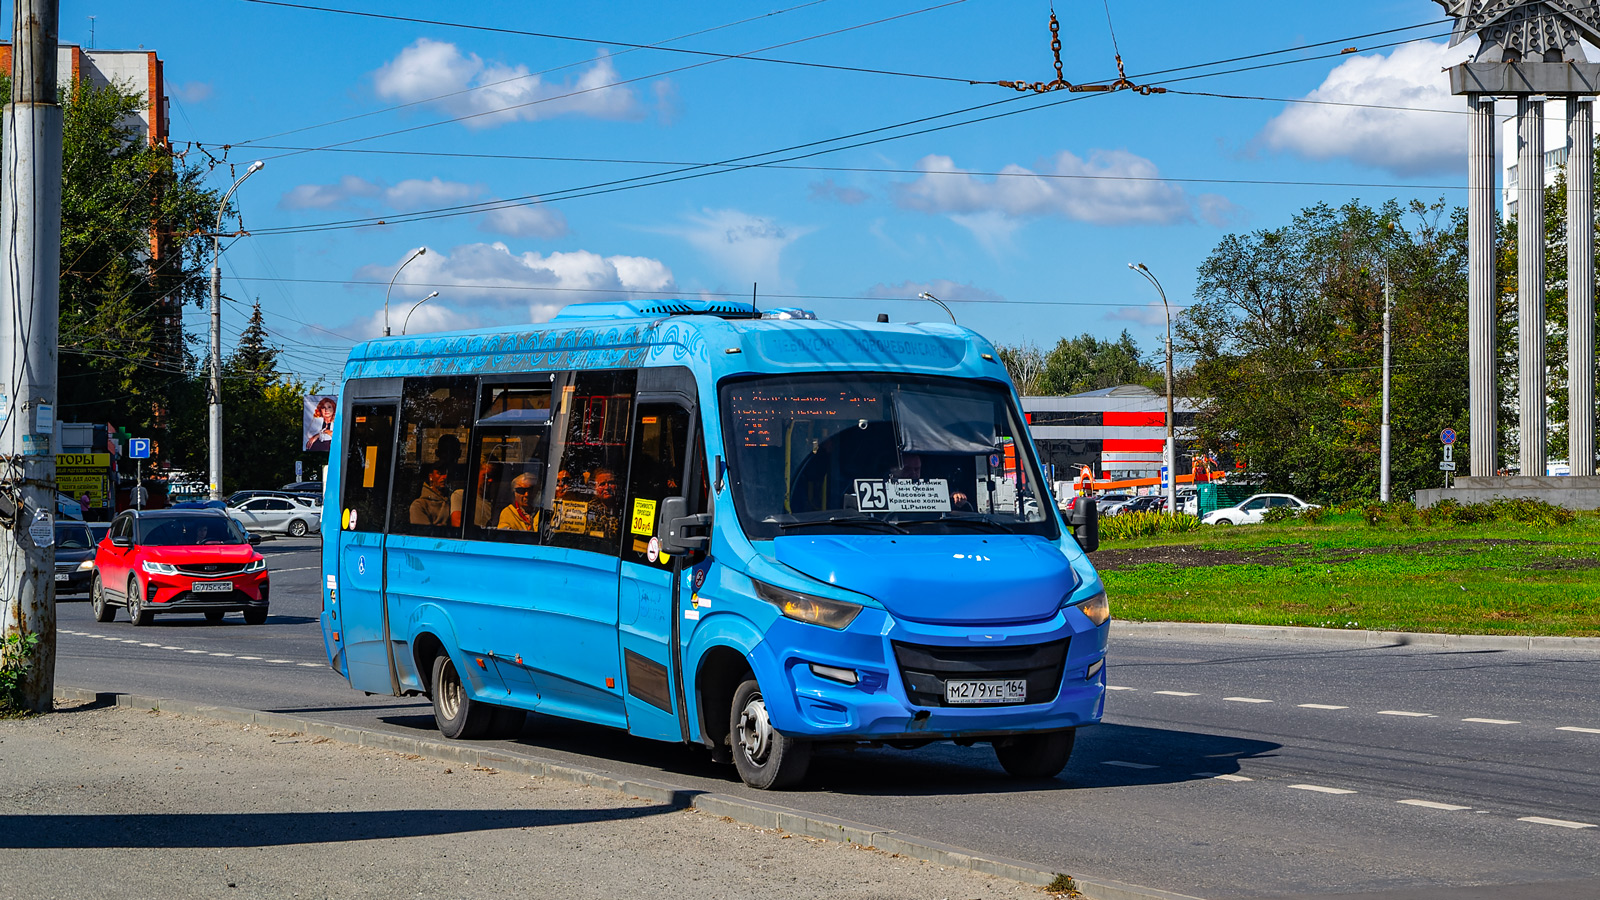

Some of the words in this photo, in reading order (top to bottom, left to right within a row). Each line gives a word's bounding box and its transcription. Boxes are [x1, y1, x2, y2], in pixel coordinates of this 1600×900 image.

[135, 441, 146, 456] P
[56, 455, 95, 465] ТОРЫ
[860, 482, 886, 508] 25
[633, 517, 643, 530] 30
[641, 522, 652, 532] руб.
[949, 682, 1003, 698] М279УЕ
[1005, 681, 1024, 693] 164
